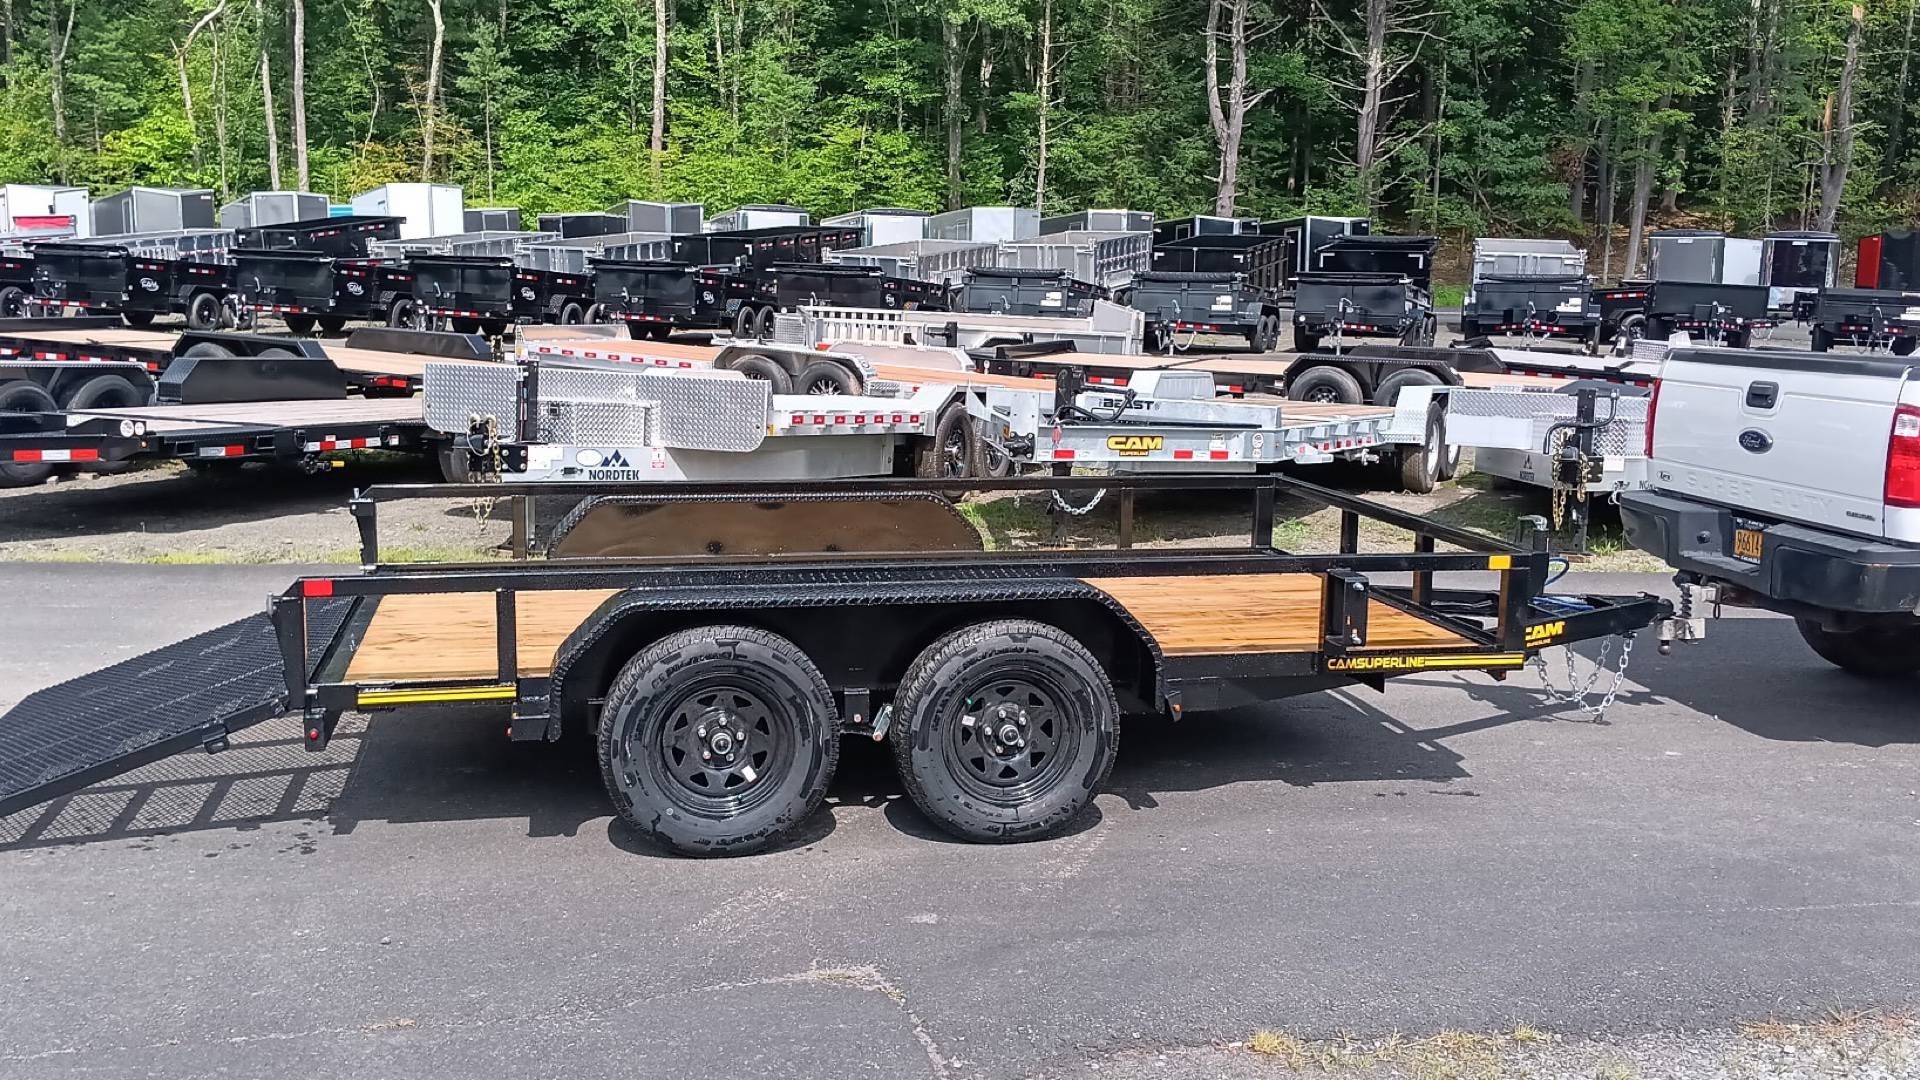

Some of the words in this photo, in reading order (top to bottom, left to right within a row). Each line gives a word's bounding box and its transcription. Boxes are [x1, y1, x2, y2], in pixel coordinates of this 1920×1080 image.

[1103, 399, 1154, 410] BEAST
[1108, 436, 1163, 450] CAM
[588, 469, 639, 481] NORDTEK
[1686, 471, 1752, 500] SUPER
[1770, 487, 1833, 516] DUTY
